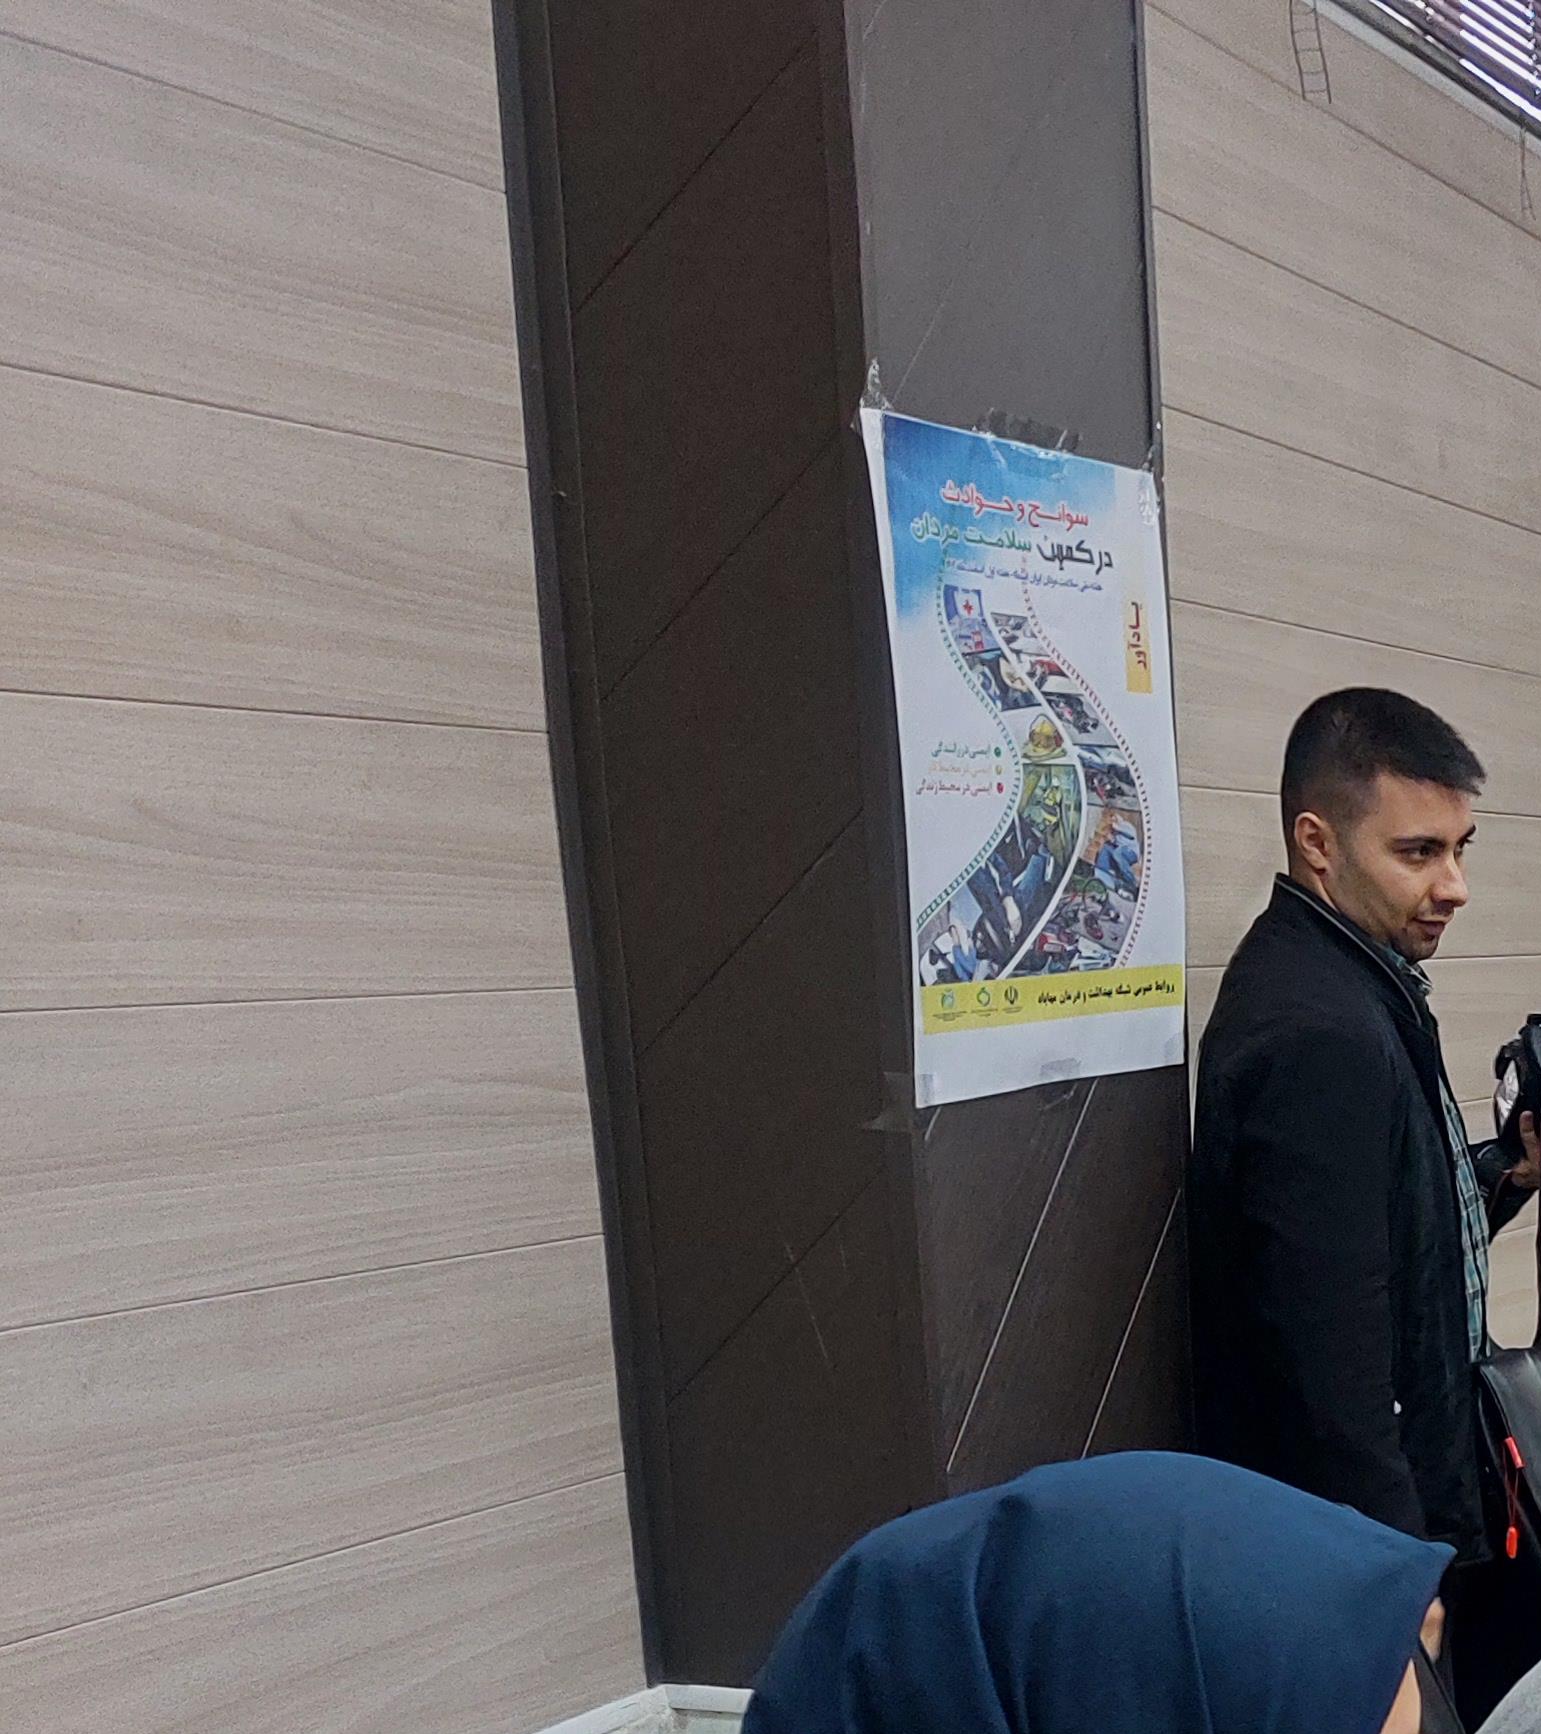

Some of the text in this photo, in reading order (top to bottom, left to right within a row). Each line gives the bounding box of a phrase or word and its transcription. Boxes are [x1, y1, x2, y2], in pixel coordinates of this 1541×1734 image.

[1017, 503, 1025, 521] و
[1028, 502, 1089, 531] سوانح
[912, 513, 959, 546] مردان
[964, 526, 1032, 552] سلامت
[1036, 535, 1095, 571] کمین
[1095, 549, 1113, 575] در
